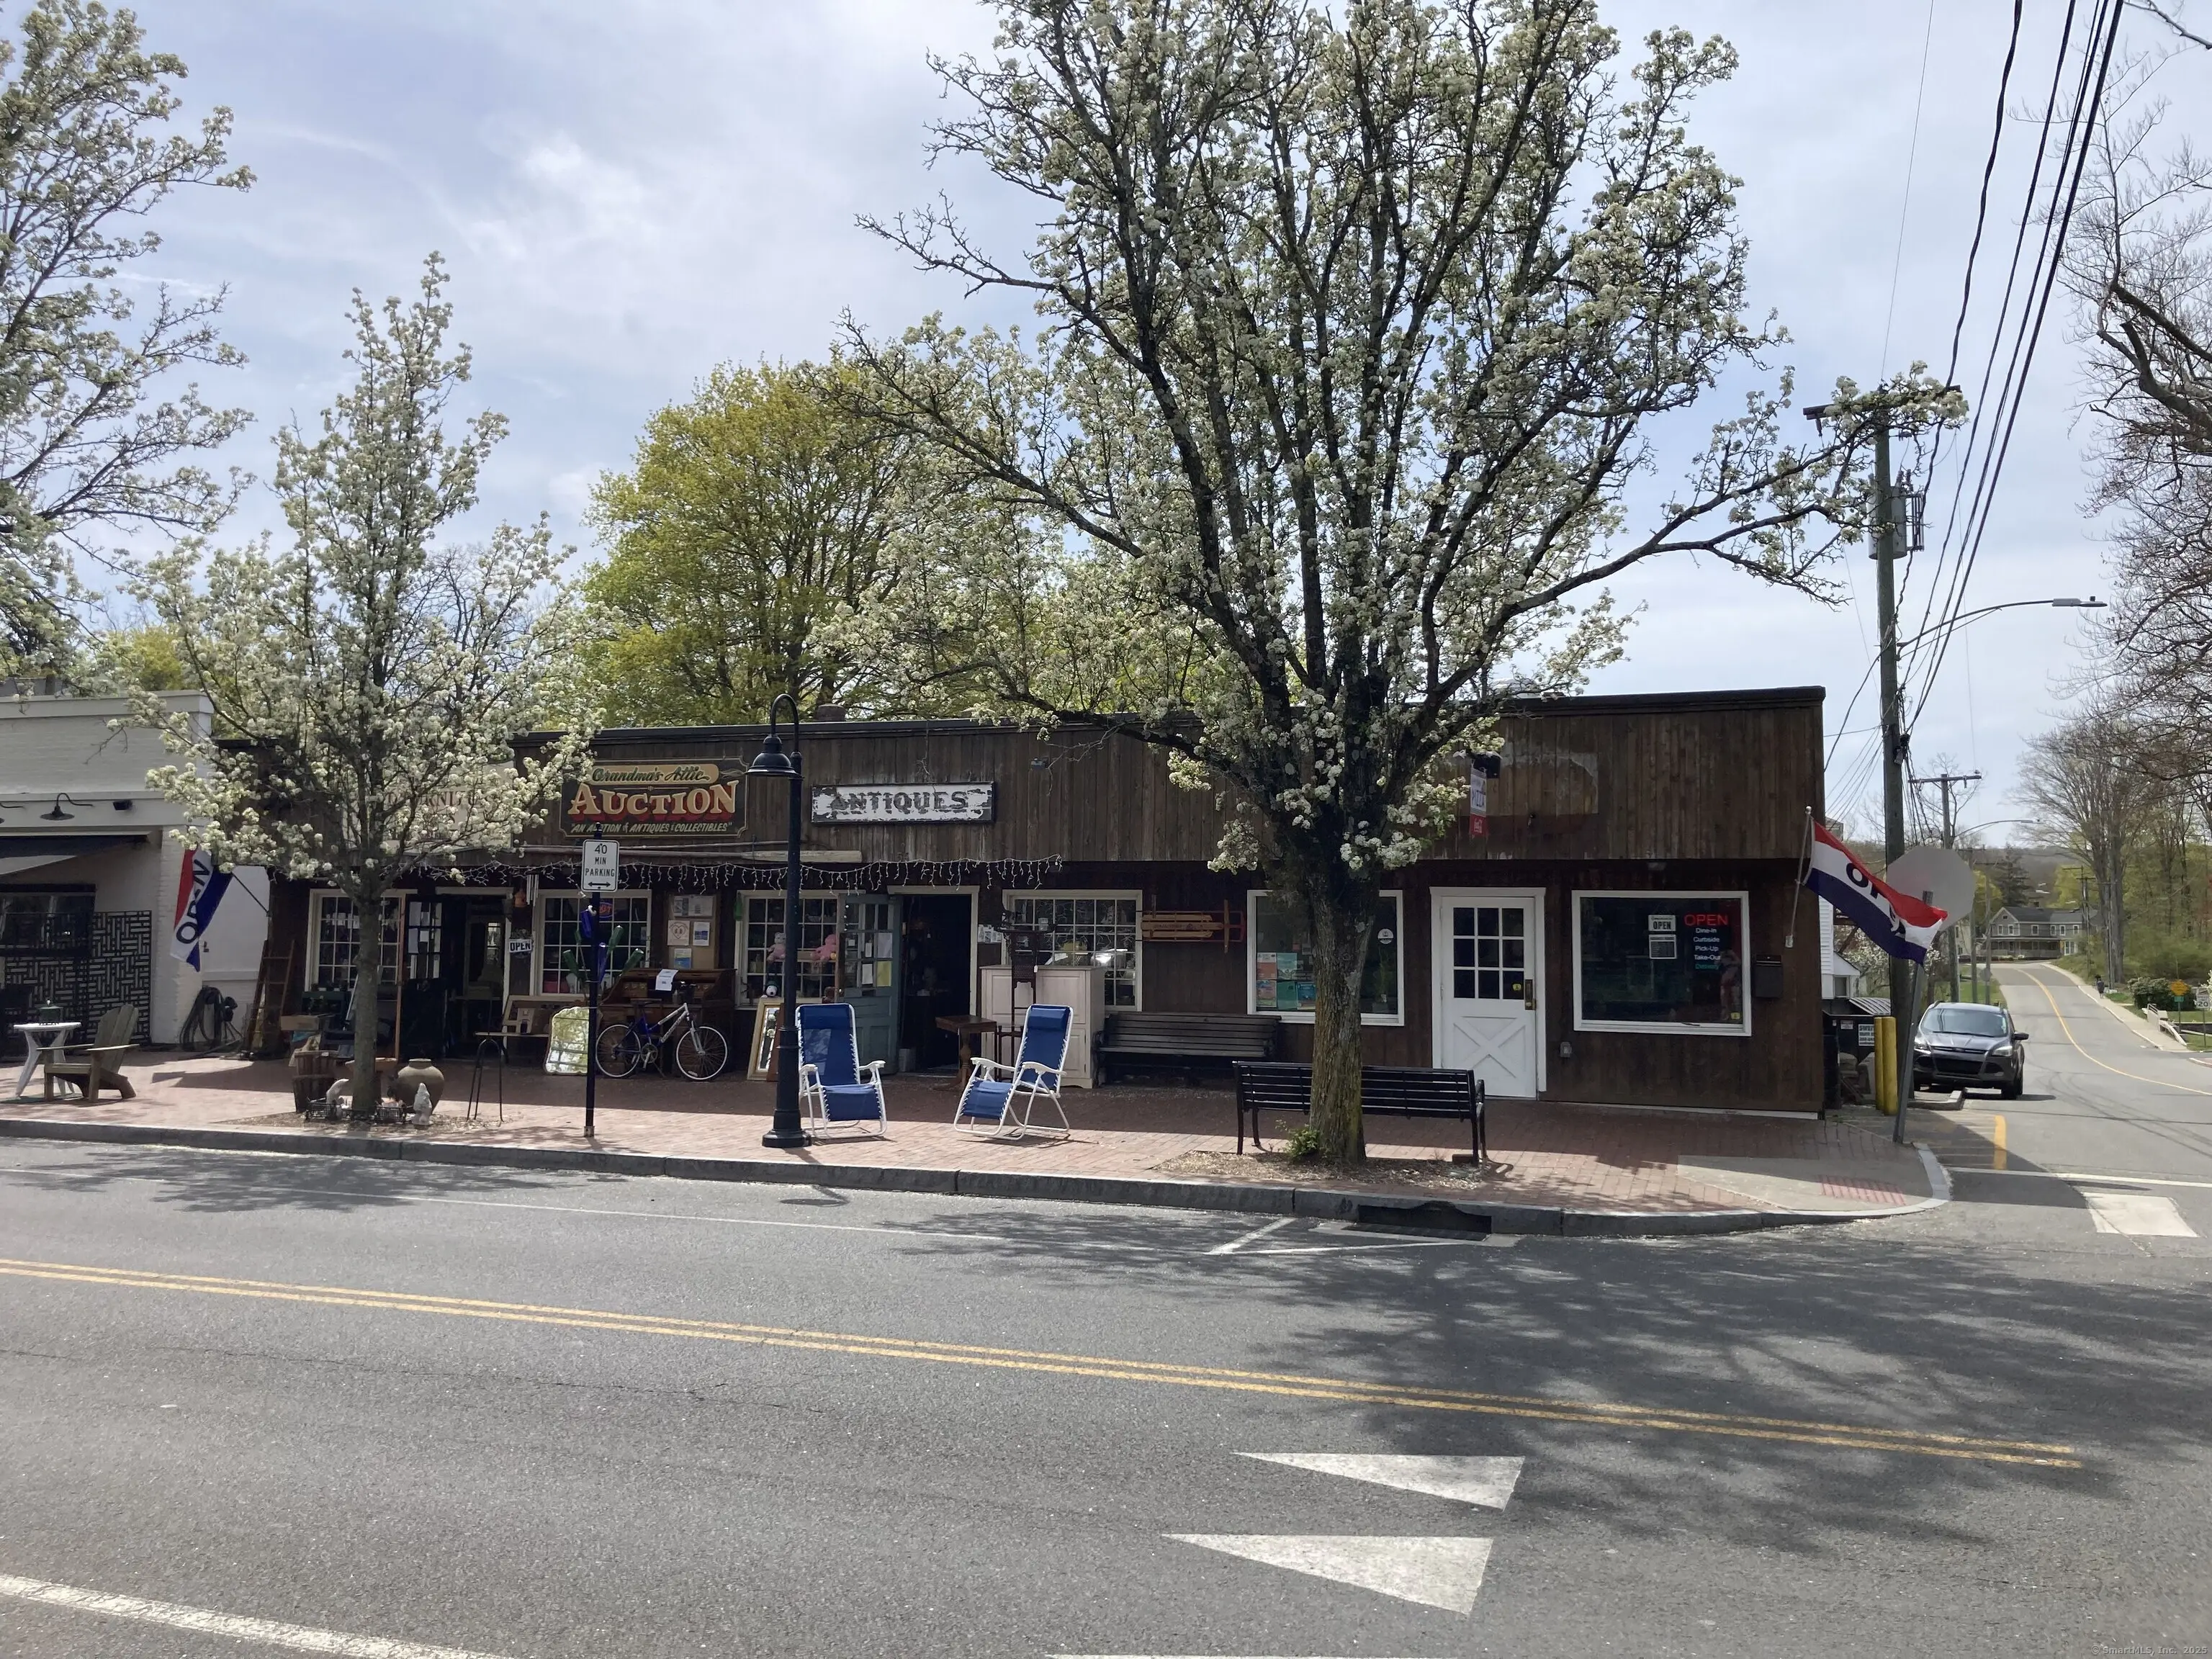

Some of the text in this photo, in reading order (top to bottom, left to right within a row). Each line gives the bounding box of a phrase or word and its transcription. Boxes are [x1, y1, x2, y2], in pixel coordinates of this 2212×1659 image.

[592, 766, 710, 782] Grandma's Attic
[567, 780, 739, 815] AUCTION
[830, 791, 969, 813] ANTIQUES
[586, 824, 621, 833] AUTION
[629, 823, 670, 834] ANTIQUES
[594, 844, 608, 854] 40
[585, 868, 615, 877] PARKING
[1684, 914, 1728, 925] OPEN
[1653, 921, 1671, 930] OPEN
[510, 943, 531, 951] OPEN
